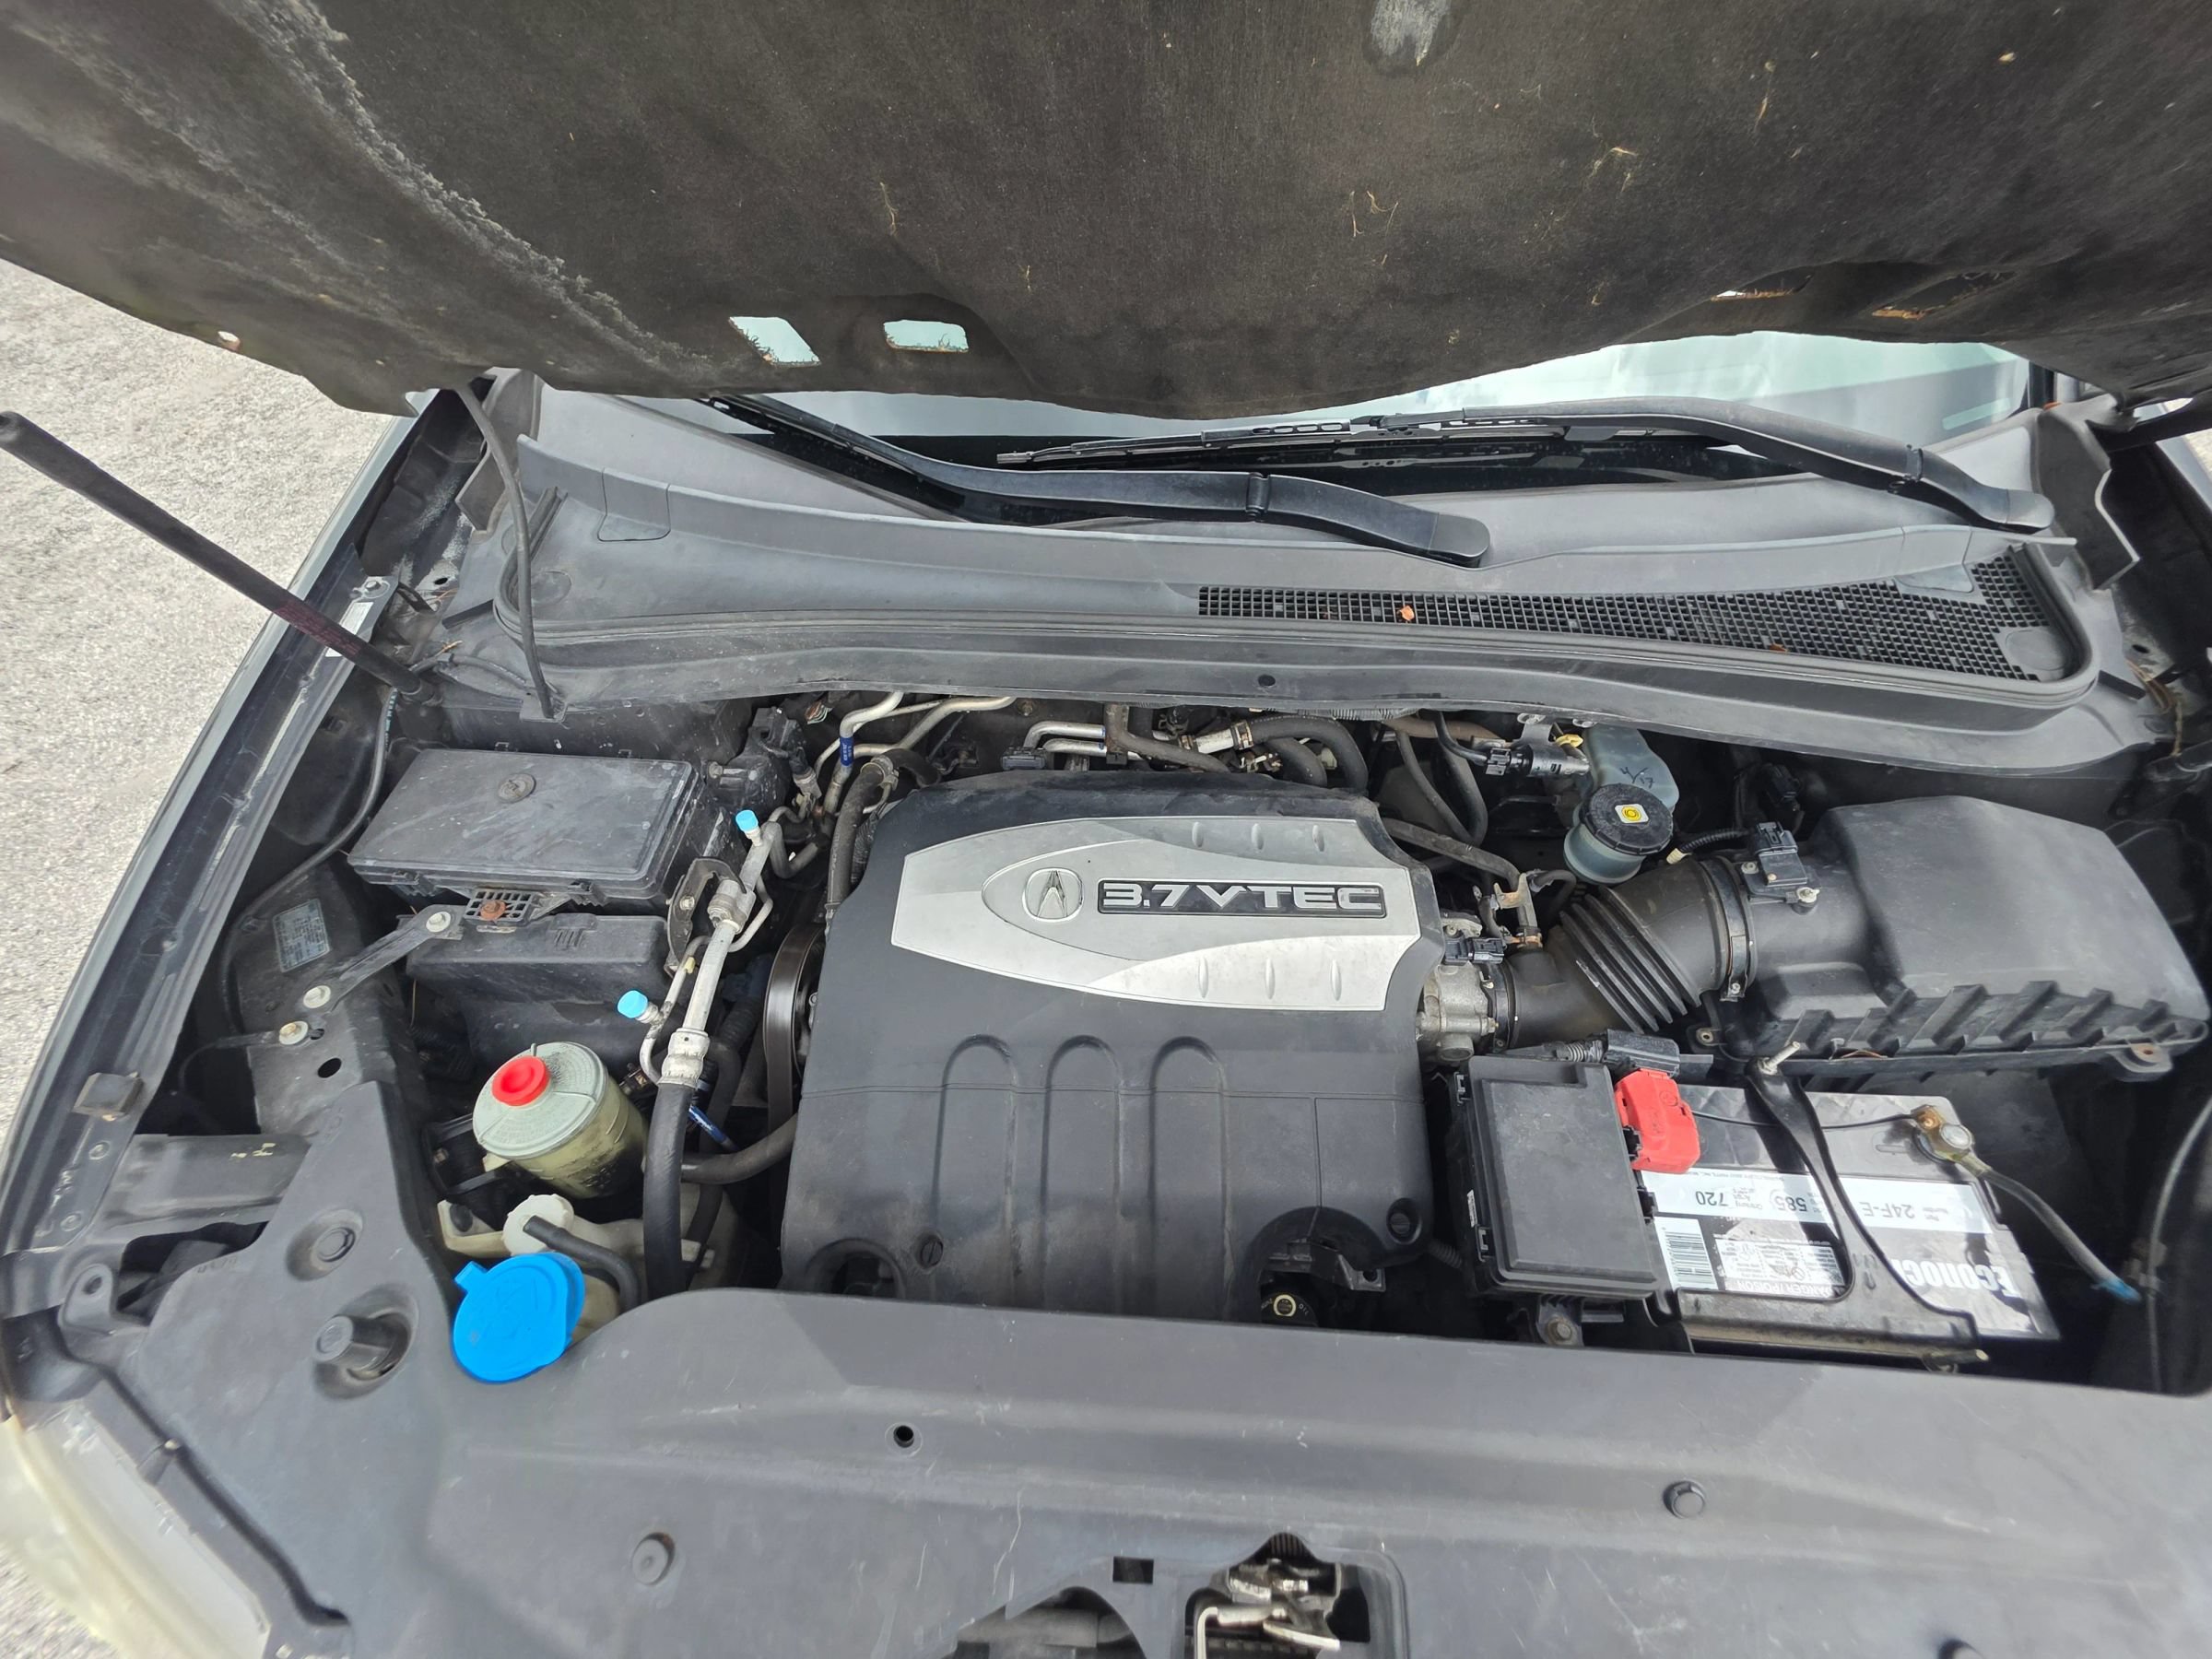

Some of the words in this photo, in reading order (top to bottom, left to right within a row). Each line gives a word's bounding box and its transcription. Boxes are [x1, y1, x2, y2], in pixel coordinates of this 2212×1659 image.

[1695, 1191, 1729, 1206] 720
[1774, 1196, 1807, 1212] 585
[1859, 1201, 1915, 1219] 24F-E
